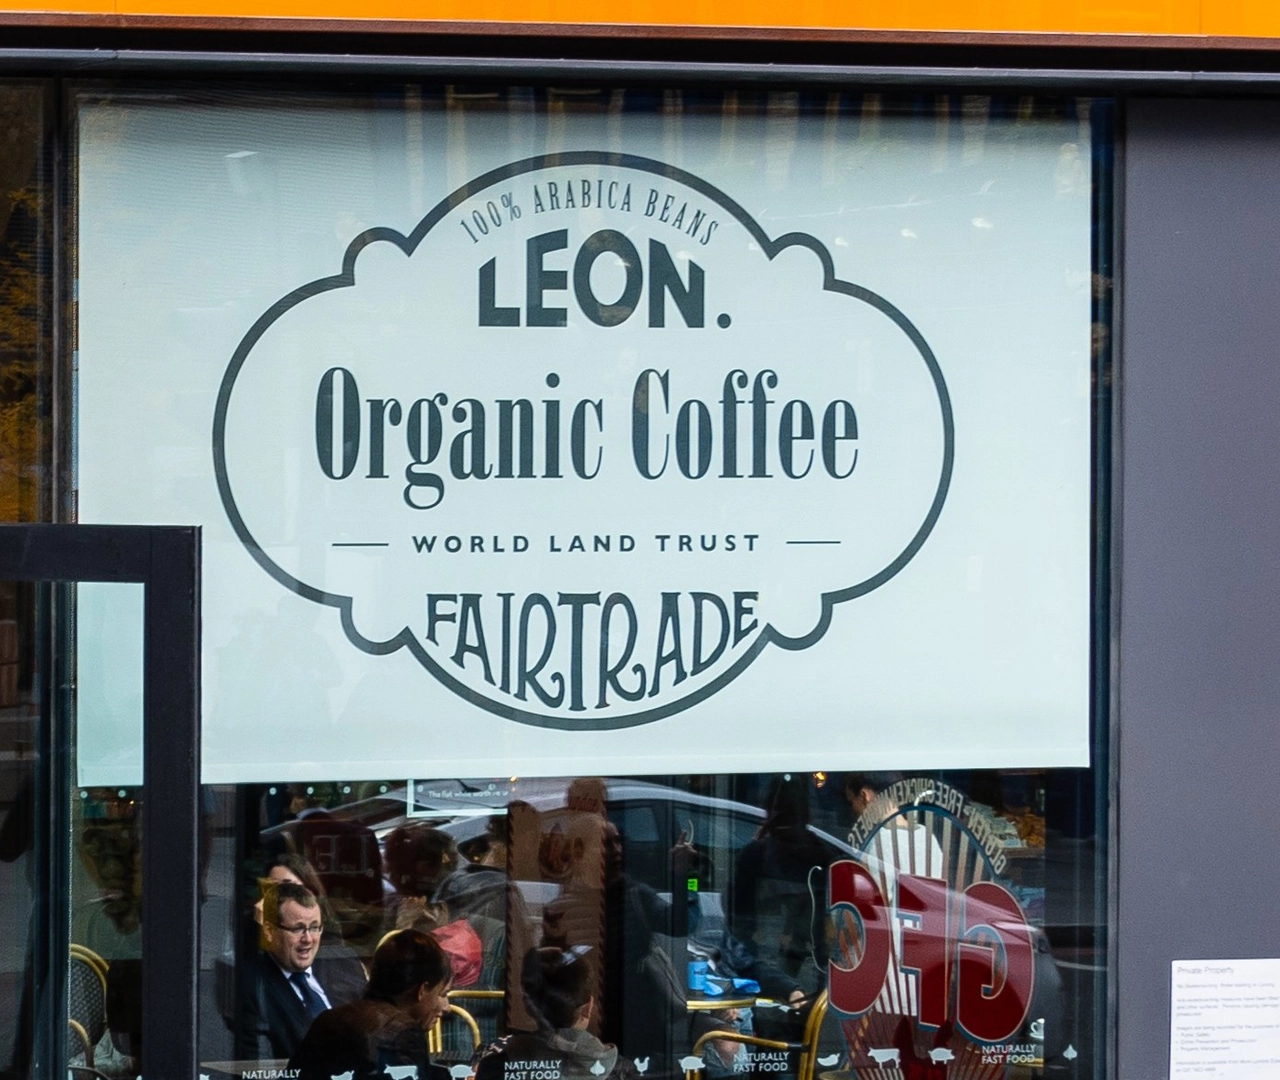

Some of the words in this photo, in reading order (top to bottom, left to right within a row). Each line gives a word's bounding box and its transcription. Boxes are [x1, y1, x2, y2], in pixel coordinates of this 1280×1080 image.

[459, 190, 522, 245] 100%
[533, 178, 634, 214] ARABICA
[644, 187, 720, 246] BEANS
[314, 366, 604, 510] Organic
[631, 367, 860, 480] Coffee
[411, 534, 531, 553] WORLD
[549, 534, 636, 553] LAND
[655, 533, 760, 552] TRUST
[425, 590, 760, 712] FAIRTRADE
[733, 1052, 789, 1063] NATURALLY
[982, 1055, 1005, 1065] FAST
[1007, 1054, 1036, 1064] FOOD
[504, 1059, 561, 1070] NATURALLY
[733, 1062, 756, 1073] FAST
[758, 1062, 788, 1072] FOOD
[242, 1068, 301, 1080] NATURALLY
[504, 1071, 527, 1080] FAST
[530, 1070, 561, 1080] FOOD
